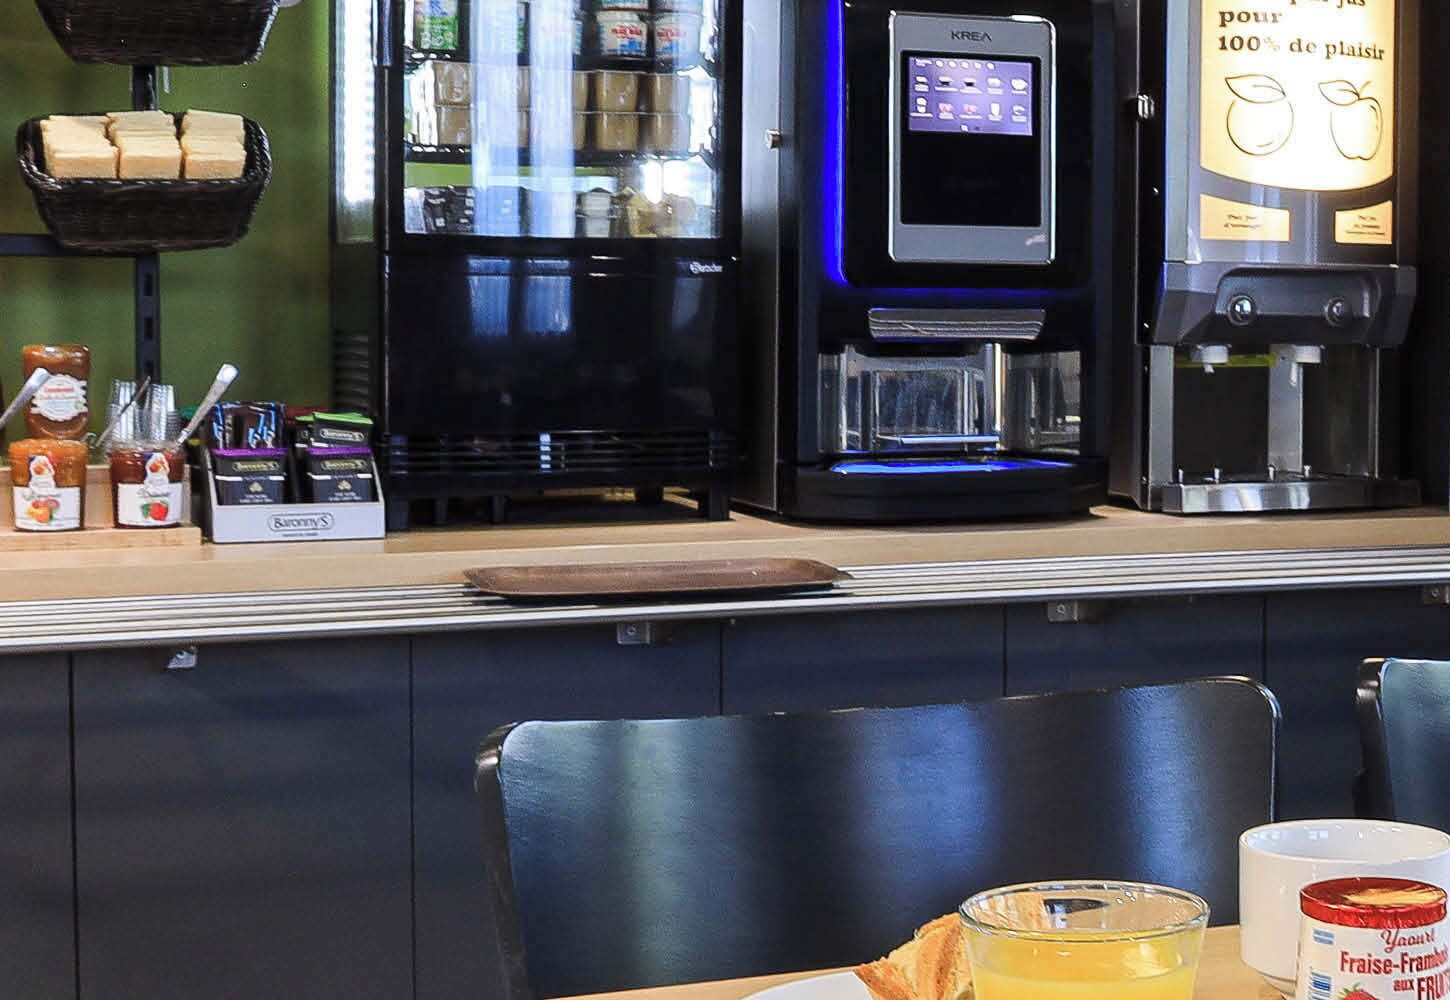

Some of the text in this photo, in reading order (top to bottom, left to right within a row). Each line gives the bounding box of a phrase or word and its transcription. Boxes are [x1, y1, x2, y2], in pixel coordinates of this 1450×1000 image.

[1218, 10, 1282, 28] pour
[951, 30, 992, 41] KREA
[1218, 35, 1385, 60] 100% de plaisir
[1393, 979, 1416, 992] aux
